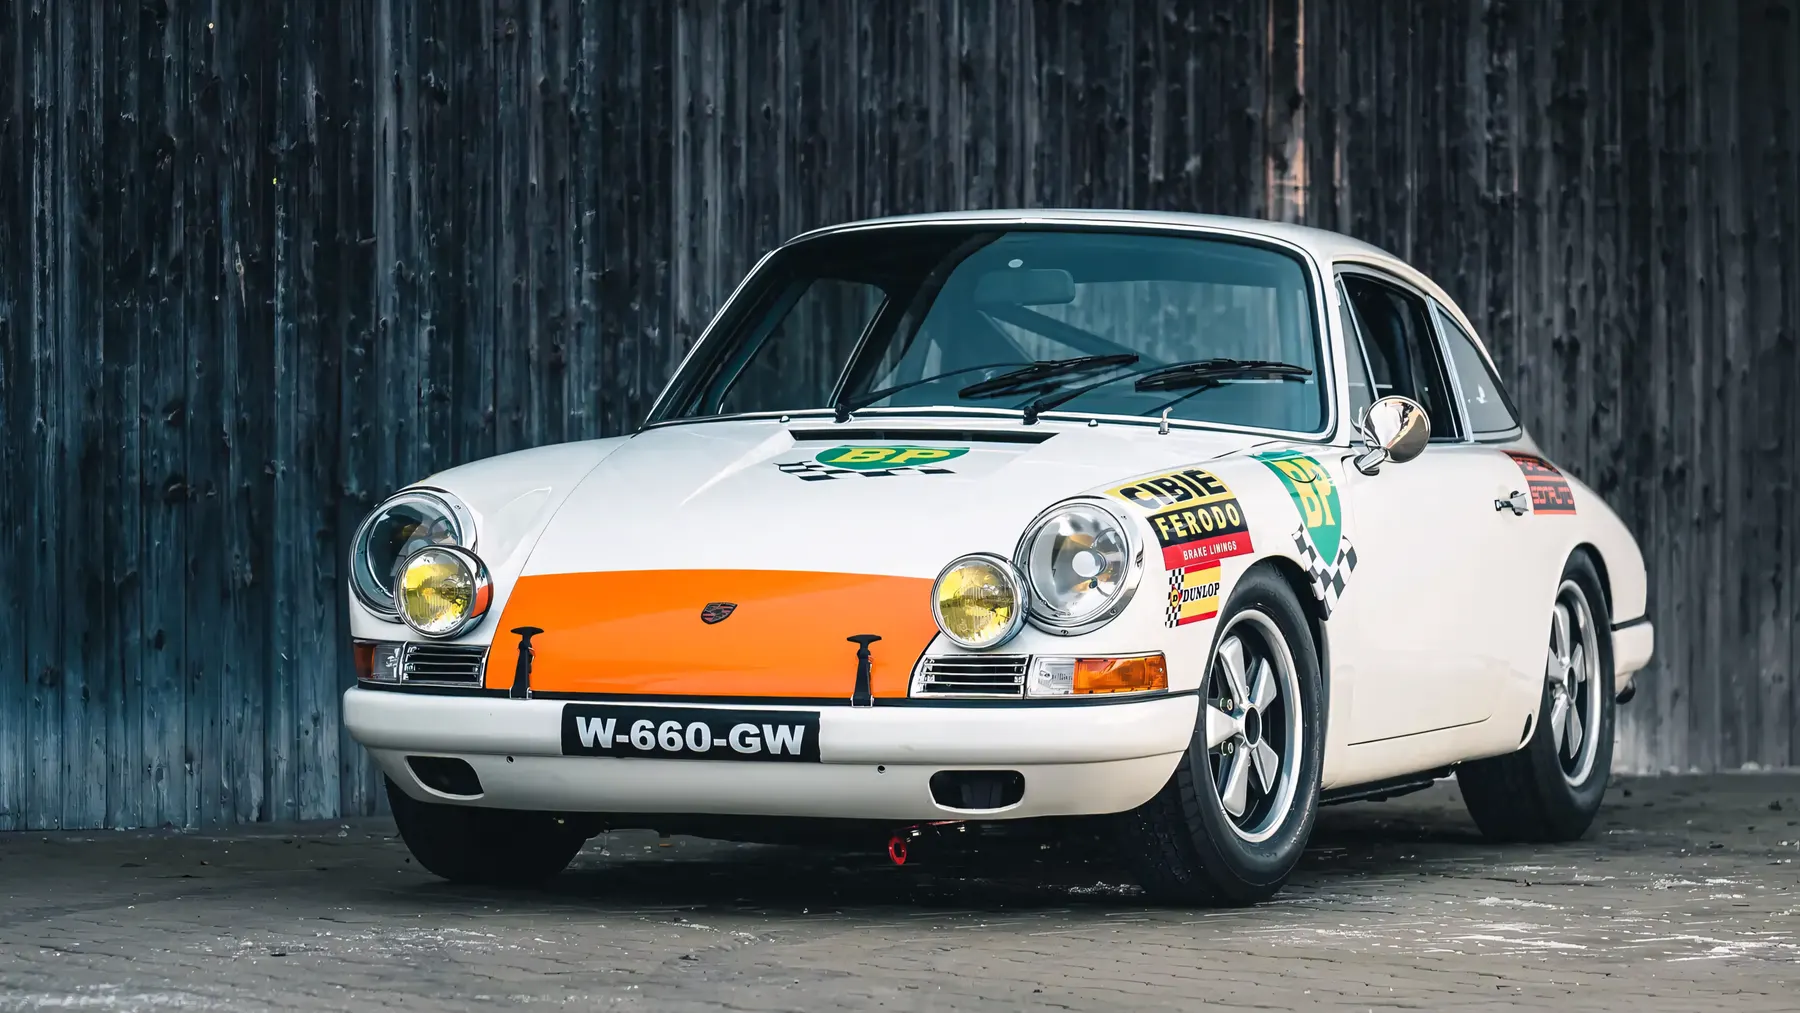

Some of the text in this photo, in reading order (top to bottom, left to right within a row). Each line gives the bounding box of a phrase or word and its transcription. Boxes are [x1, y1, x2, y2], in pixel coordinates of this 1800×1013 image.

[826, 448, 951, 464] BP
[1273, 458, 1336, 528] BP
[1154, 503, 1240, 540] FERODO
[1183, 540, 1238, 561] BRAKE LININGS
[1182, 582, 1221, 603] DUNLOP
[575, 716, 806, 756] W-660-GW
